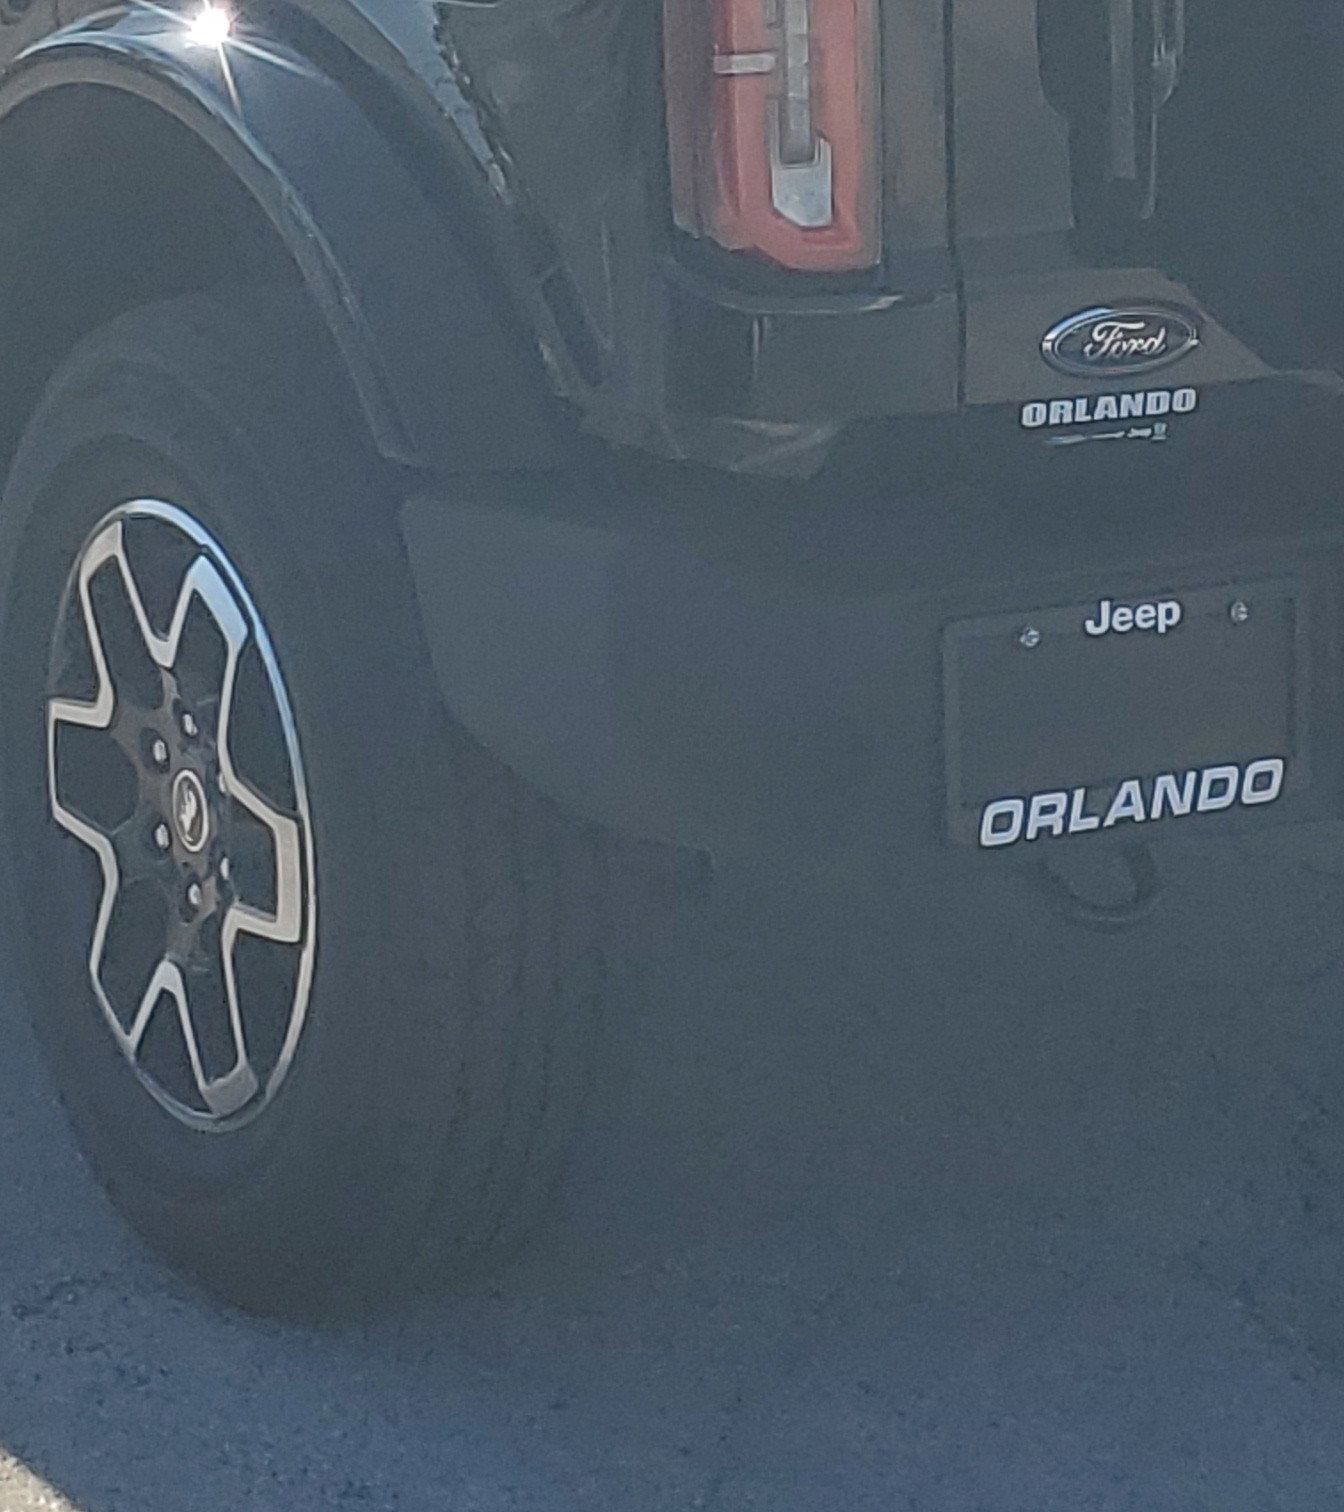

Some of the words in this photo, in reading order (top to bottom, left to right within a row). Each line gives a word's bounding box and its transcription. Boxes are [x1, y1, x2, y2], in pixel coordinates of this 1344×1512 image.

[1083, 319, 1166, 359] Ford
[1021, 387, 1198, 428] ORLANDO
[1084, 599, 1181, 636] Jeep
[979, 758, 1285, 848] ORLANDO
